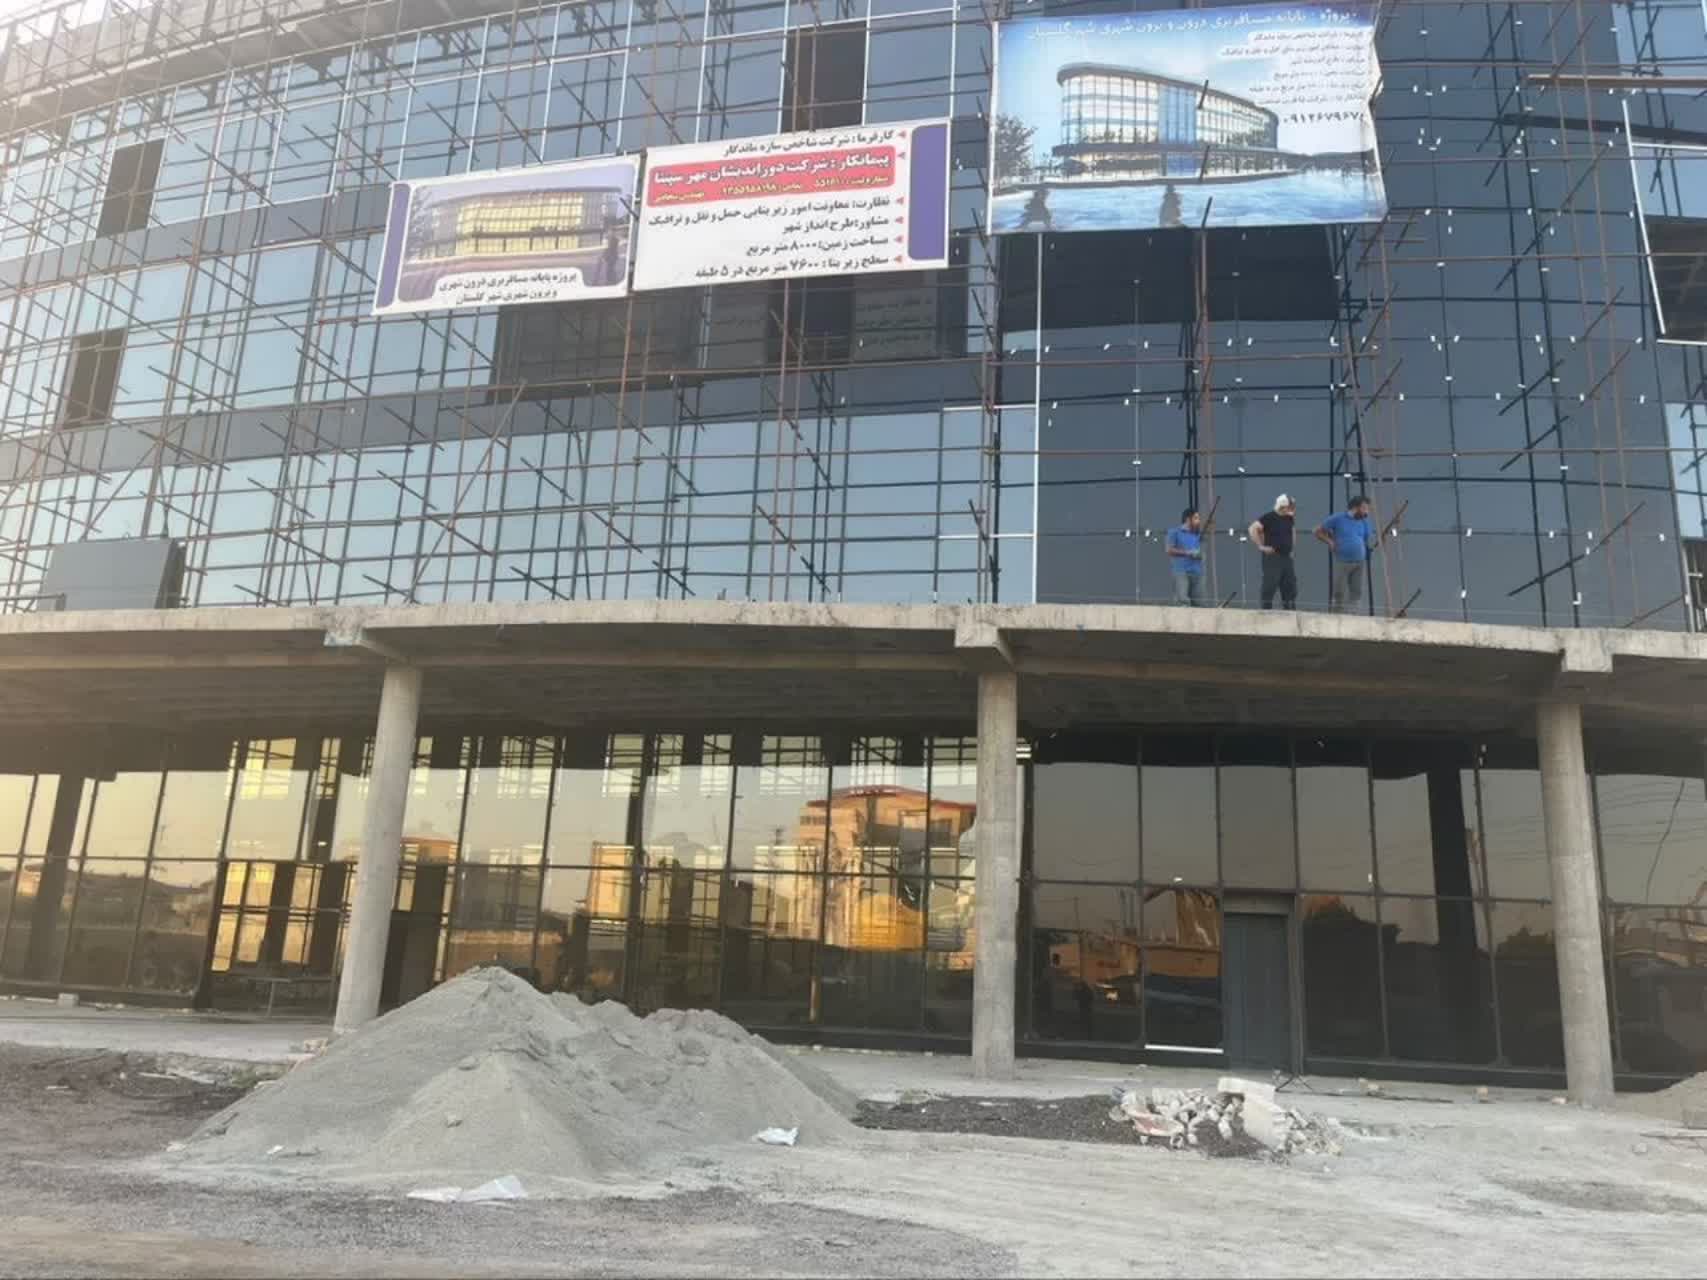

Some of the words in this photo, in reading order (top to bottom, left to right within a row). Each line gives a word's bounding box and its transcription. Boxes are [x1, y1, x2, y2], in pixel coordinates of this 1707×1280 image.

[760, 140, 782, 153] سازه
[783, 137, 818, 151] شاخص
[819, 136, 850, 148] شرکت
[785, 157, 827, 175] شرکت
[790, 202, 811, 216] امور
[813, 200, 850, 214] معاونت
[648, 213, 683, 227] ترافیک
[691, 211, 709, 224] نقل
[710, 213, 717, 222] و
[718, 208, 741, 221] حمل
[684, 216, 690, 226] و
[830, 217, 854, 231] طرح
[782, 224, 802, 235] شهر
[850, 234, 890, 247] مساحت
[746, 245, 771, 257] مربع
[773, 245, 788, 255] متر
[789, 259, 819, 271] ۷۶۰۰
[861, 255, 889, 269] سطح
[695, 268, 719, 279] طبقه
[722, 264, 729, 278] ۵
[730, 268, 744, 279] در
[745, 265, 770, 277] مربع
[773, 264, 788, 275] متر
[439, 281, 463, 292] شهری
[463, 278, 486, 289] درون
[487, 274, 529, 288] مسافربری
[503, 291, 529, 302] شهری
